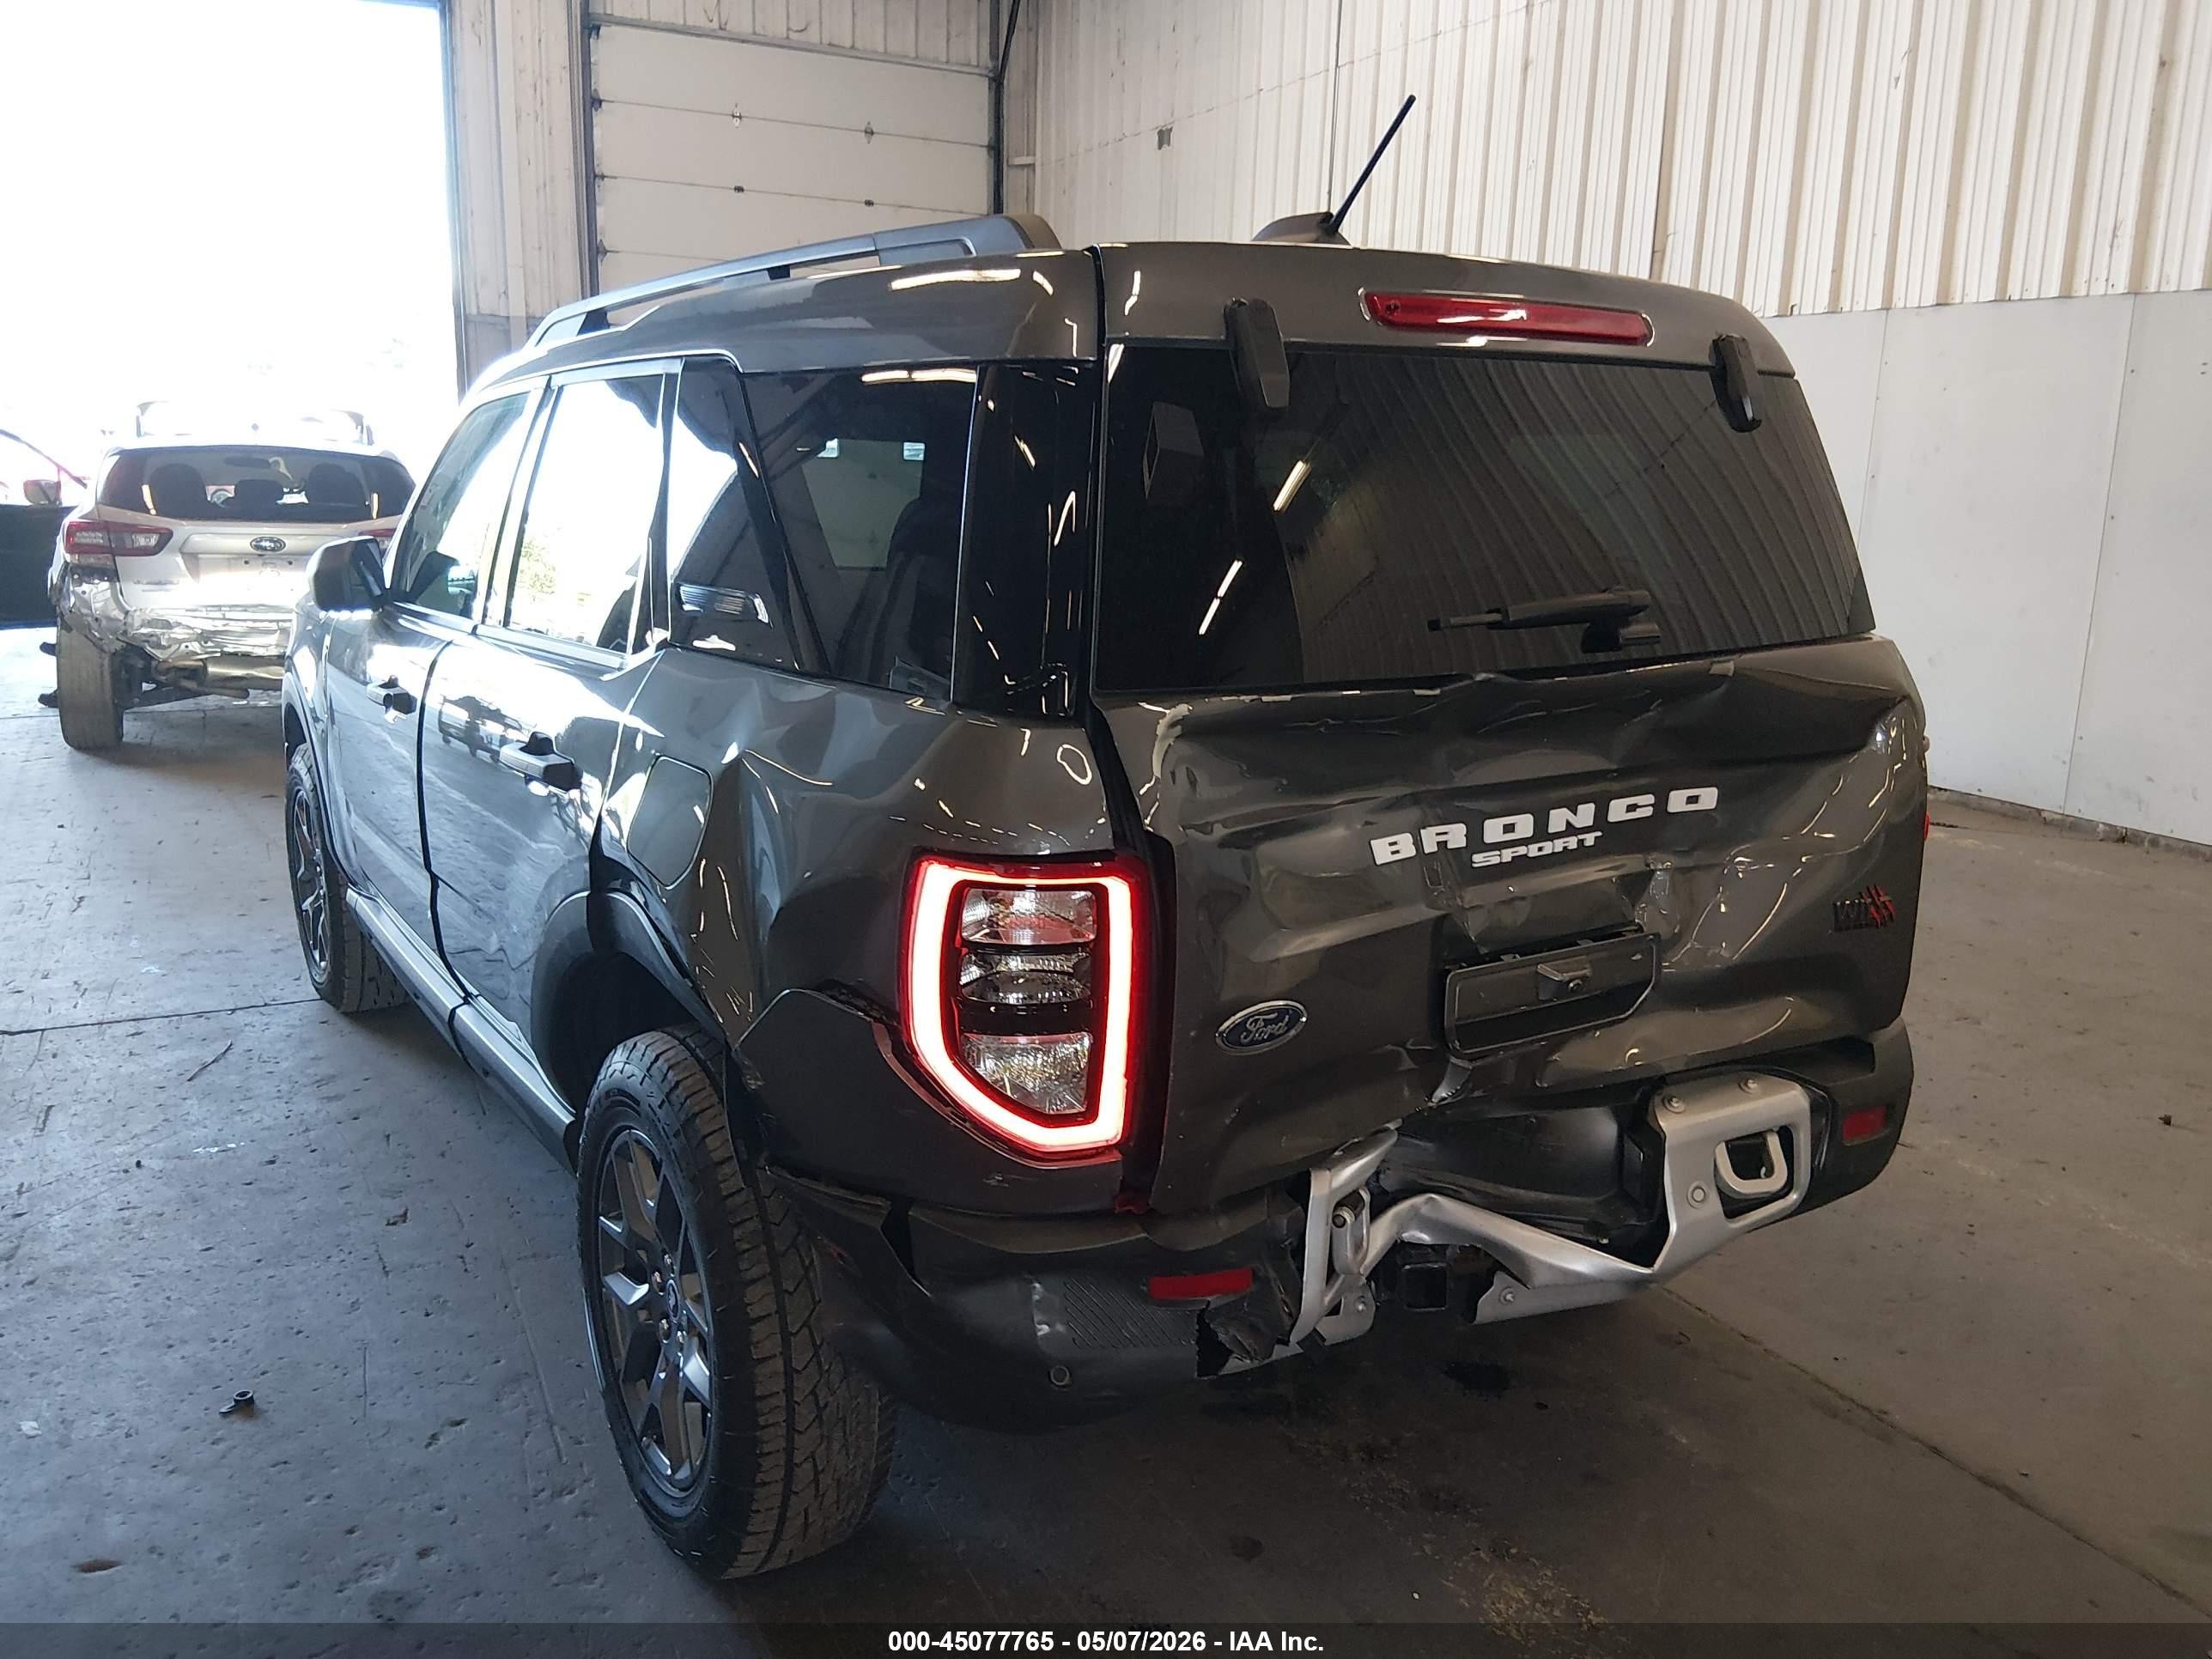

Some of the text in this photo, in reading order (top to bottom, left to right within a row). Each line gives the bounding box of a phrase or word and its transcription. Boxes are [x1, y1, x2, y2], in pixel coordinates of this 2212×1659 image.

[1370, 787, 1718, 866] BRONCO
[1471, 830, 1602, 868] SPORT
[1240, 1012, 1289, 1044] Ford
